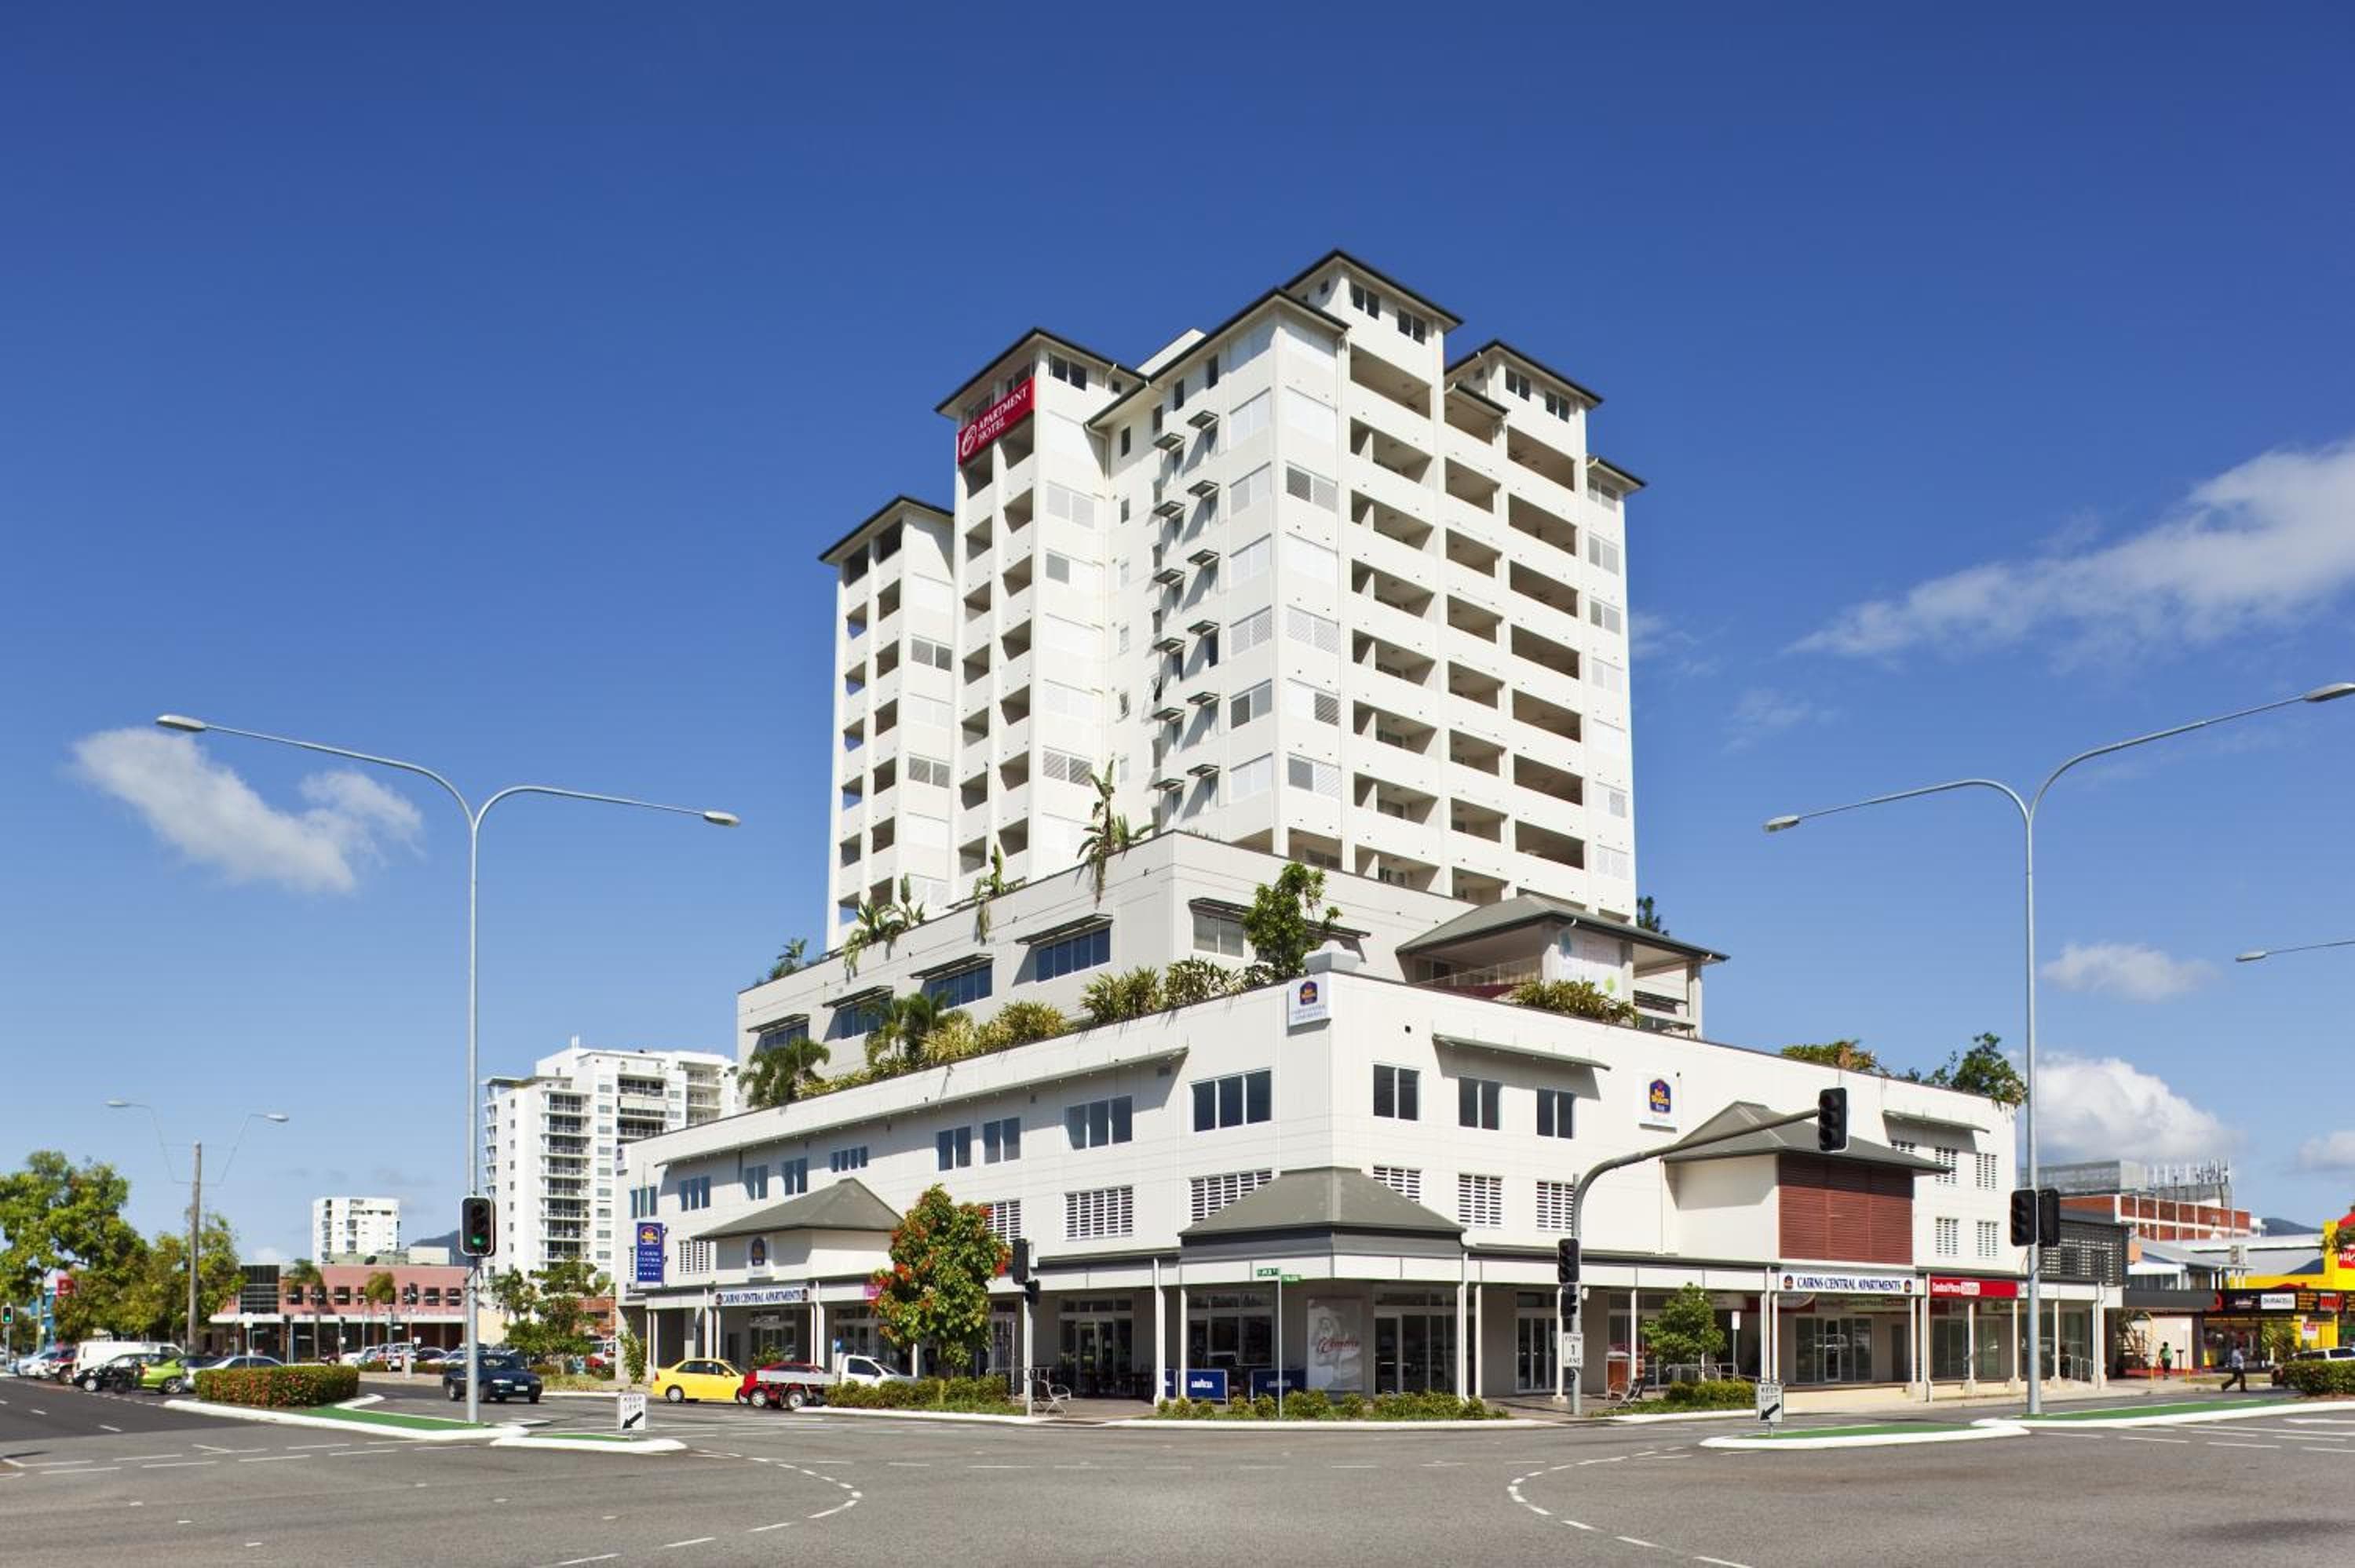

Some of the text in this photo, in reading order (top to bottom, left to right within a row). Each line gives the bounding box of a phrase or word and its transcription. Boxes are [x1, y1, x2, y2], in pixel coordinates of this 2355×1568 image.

[979, 385, 1028, 428] APARTMENT
[978, 416, 1005, 440] HOTEL
[1797, 1277, 1823, 1289] CAIRNS
[1824, 1278, 1856, 1289] CENTRAL
[1858, 1278, 1901, 1291] APARTMENTS
[723, 1290, 801, 1304] CAIRNS CENTRAL APARTMENTS
